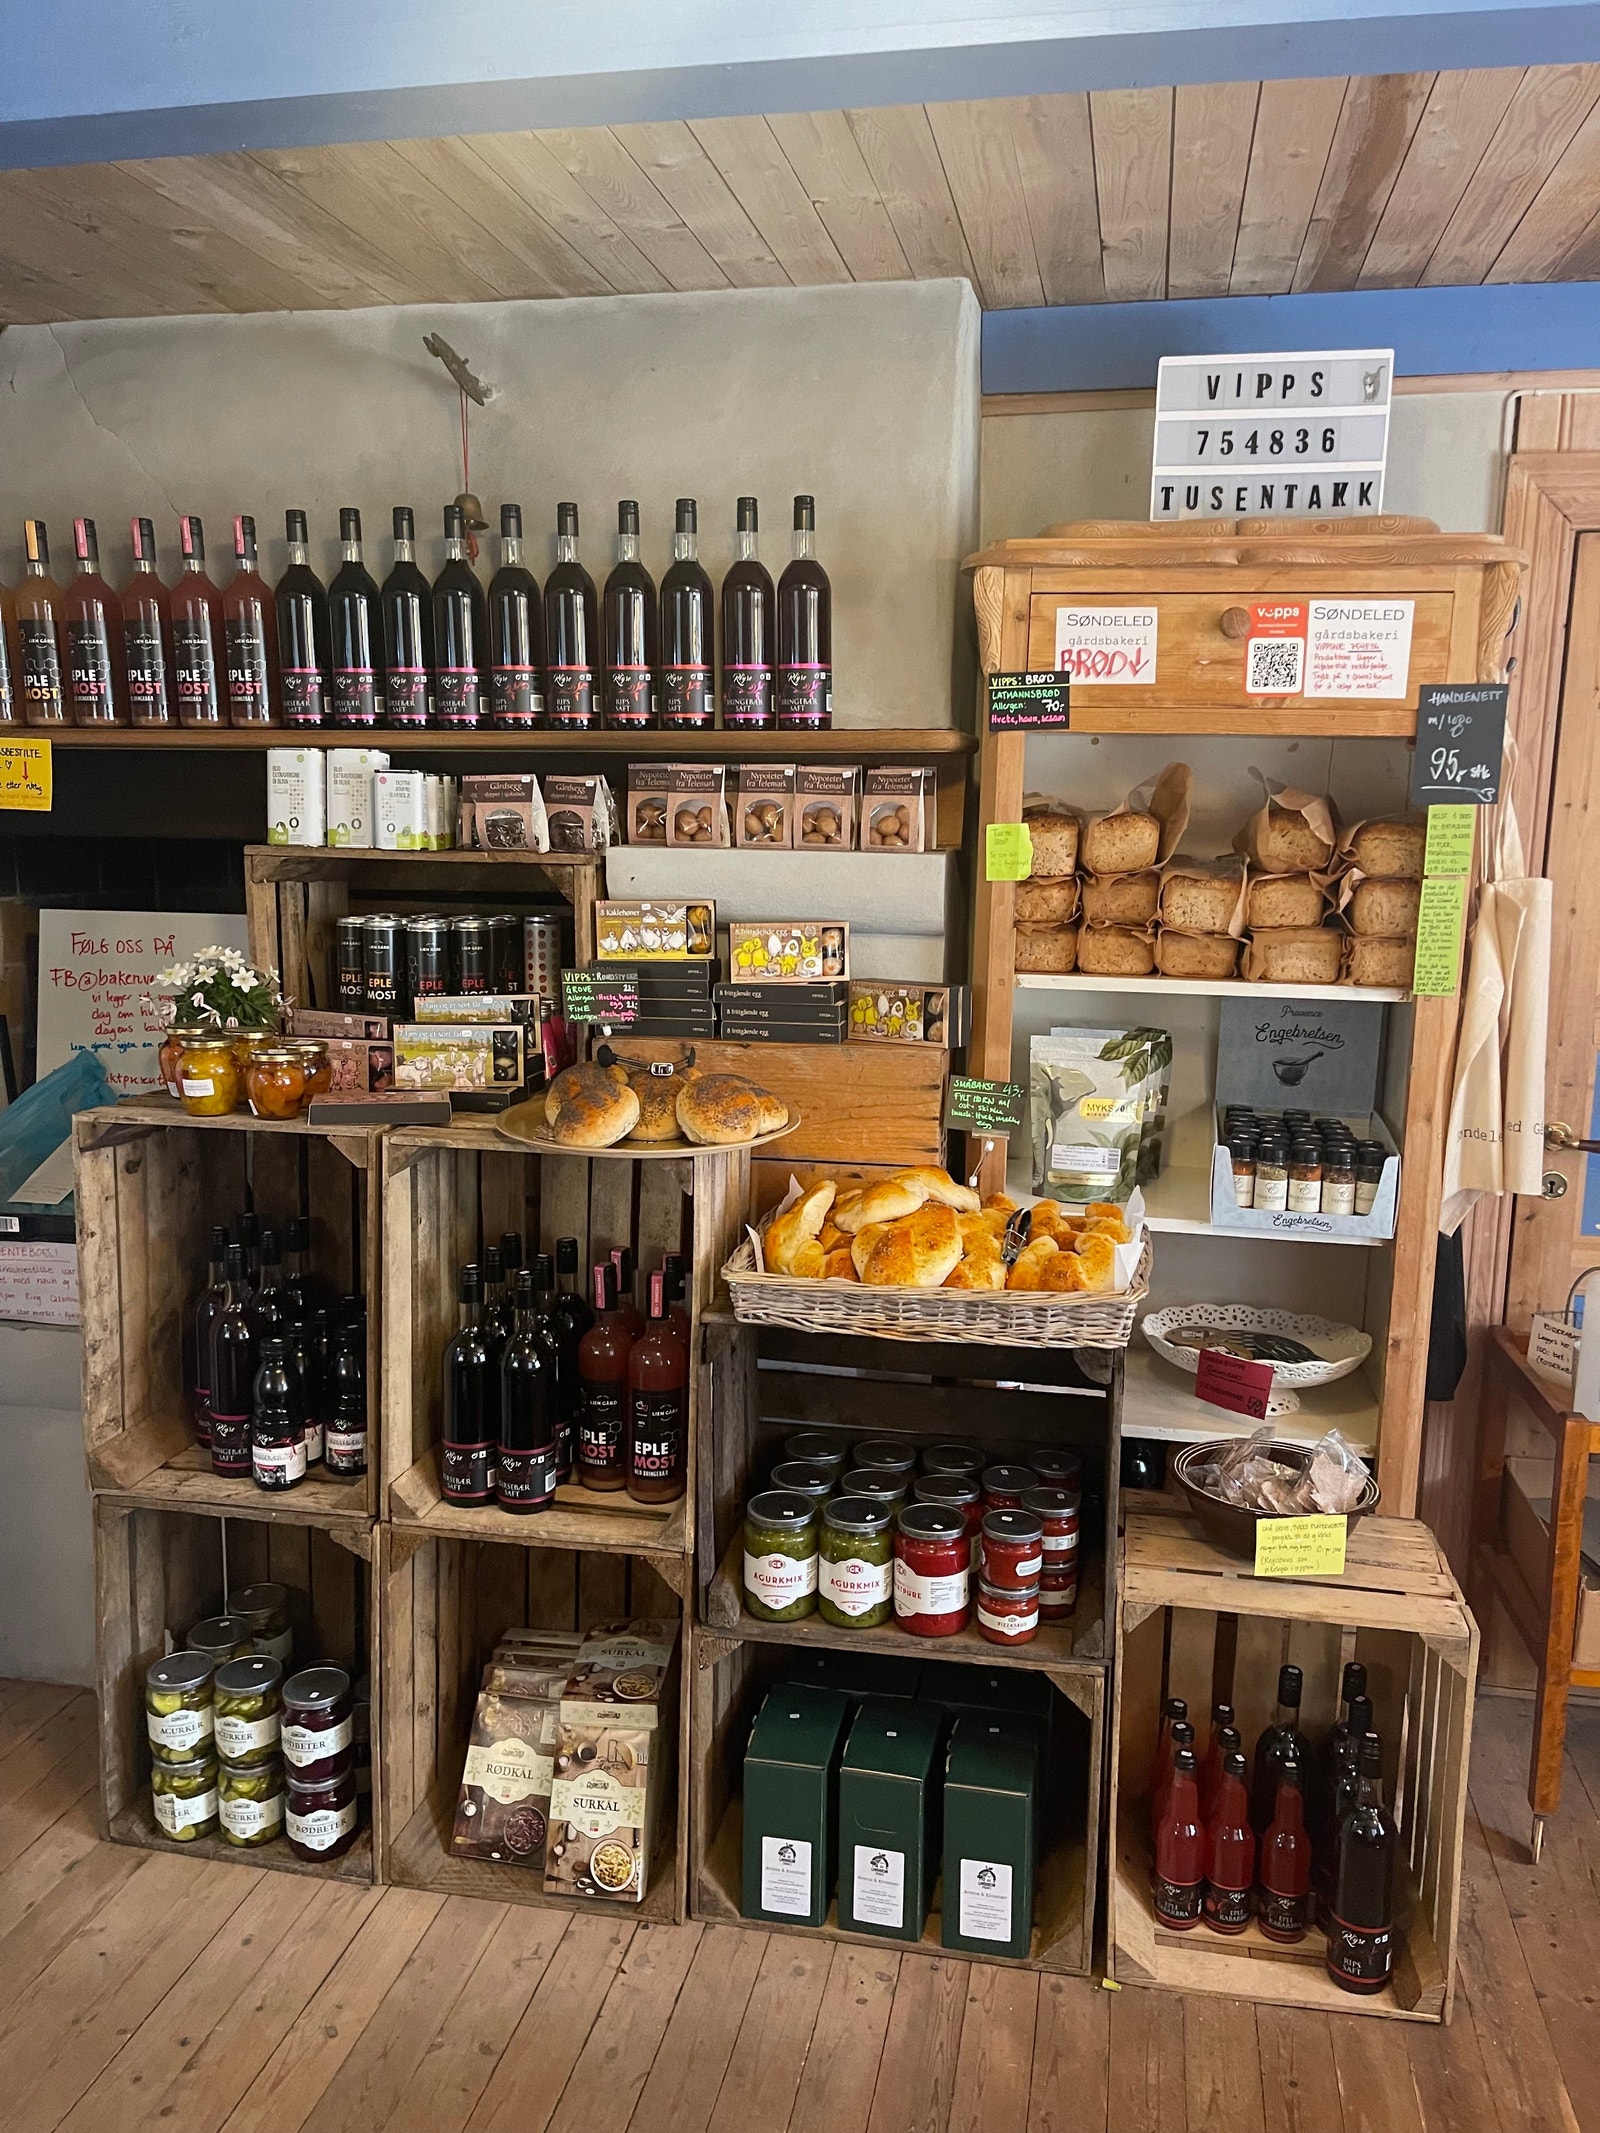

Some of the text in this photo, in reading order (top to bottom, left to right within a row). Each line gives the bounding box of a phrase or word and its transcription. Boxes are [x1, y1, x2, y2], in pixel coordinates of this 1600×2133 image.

[1207, 372, 1324, 400] VIPPS
[1197, 428, 1334, 456] 754836
[1161, 482, 1373, 511] TUSENTAKK
[1314, 606, 1405, 621] SØNDELED
[1067, 614, 1153, 627] SØNDELED
[1069, 635, 1149, 648] gårdsbakeri
[1314, 629, 1398, 641] gårdsbakeri
[1060, 648, 1128, 680] BRØD
[1025, 674, 1054, 686] BRØD
[0, 748, 42, 758] SBESTILTE
[490, 782, 522, 793] Gårdsegg
[555, 783, 586, 794] Gårdsegg
[71, 932, 176, 957] FØLG OSS PÅ
[341, 973, 363, 983] EPLE
[368, 978, 392, 988] EPLE
[462, 978, 485, 988] EPLE
[340, 985, 365, 994] MOS
[420, 981, 444, 990] EPLE
[566, 985, 592, 994] GROVE
[367, 990, 397, 1000] MOST
[568, 1004, 590, 1012] FINE
[1281, 1004, 1323, 1018] Provence
[92, 1008, 111, 1025] dag
[1255, 1022, 1345, 1050] Engebretsen
[1272, 1214, 1332, 1232] Engebretsen
[635, 1441, 669, 1455] EPLE
[634, 1454, 676, 1470] MOST
[754, 1572, 802, 1584] AGURKMIX
[831, 1578, 880, 1589] AGURKMIX
[160, 1721, 204, 1735] AGURKER
[486, 1763, 534, 1780] RØDKÅL
[573, 1796, 620, 1812] SURKÅL
[225, 1812, 264, 1821] AGURKER
[296, 1818, 347, 1833] RØDBETER
